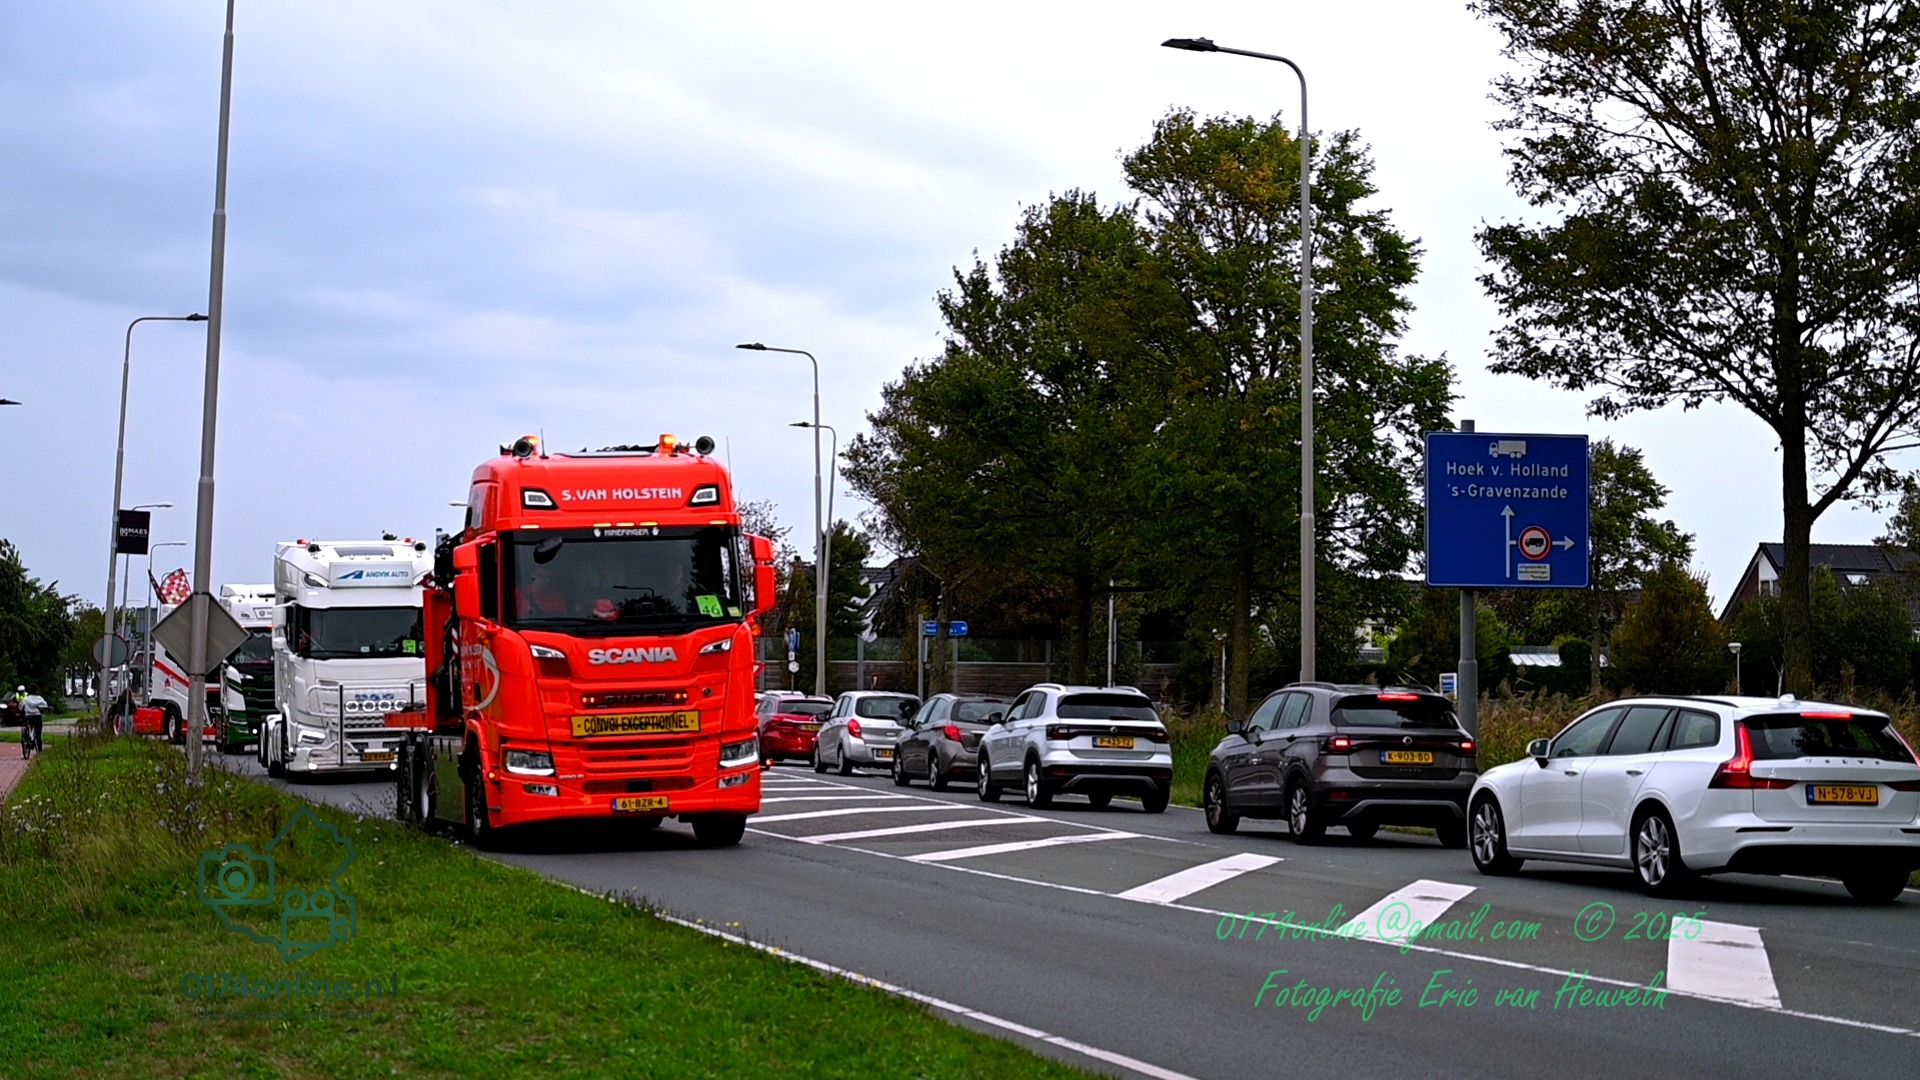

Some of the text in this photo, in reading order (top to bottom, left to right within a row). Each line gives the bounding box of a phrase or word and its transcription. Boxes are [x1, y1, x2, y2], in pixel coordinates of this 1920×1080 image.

[1446, 461, 1568, 477] Hoek v. Holland
[561, 487, 682, 501] S.VAN HOLSTEIN
[1447, 483, 1568, 498] 's-Gravenzande
[588, 646, 678, 665] SCANIA
[621, 714, 690, 731] EXCEPTIONNEL
[1387, 752, 1430, 761] K-903-BD
[1817, 787, 1873, 800] N-578-VJ
[621, 797, 664, 809] 61-BZR-4
